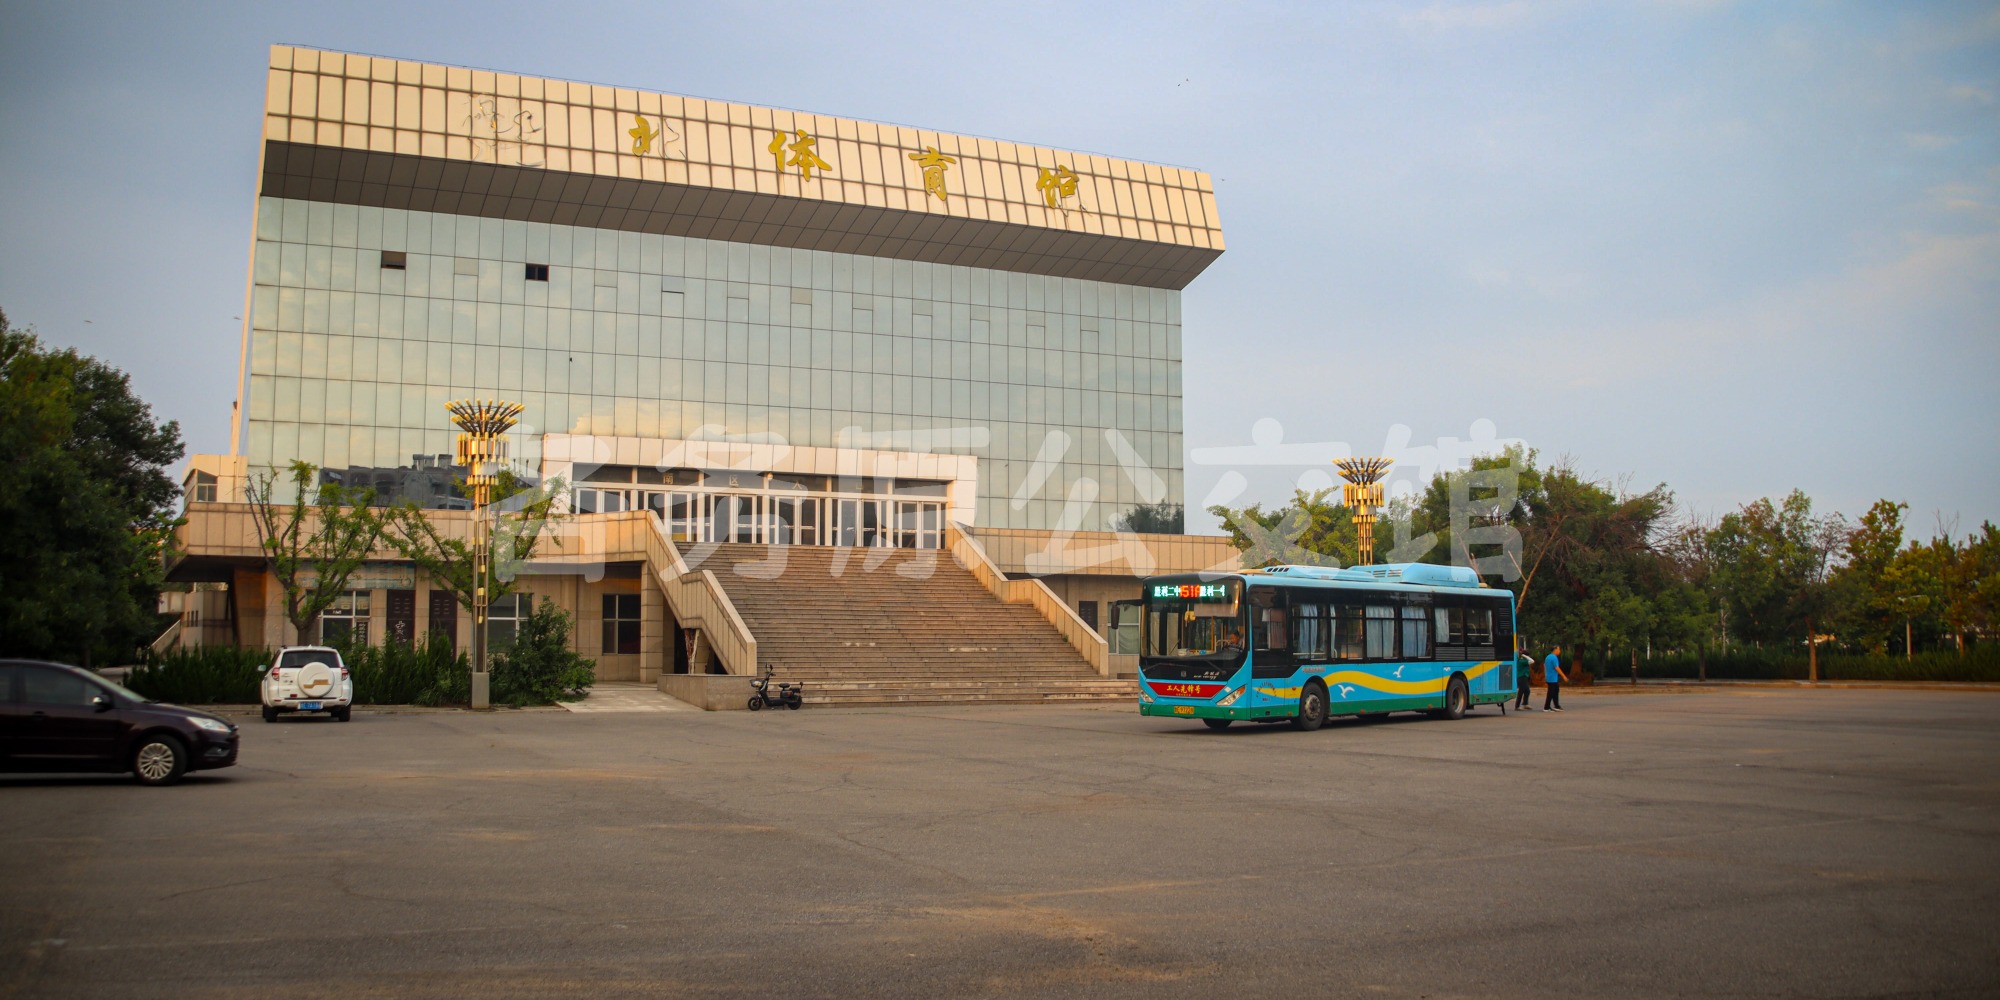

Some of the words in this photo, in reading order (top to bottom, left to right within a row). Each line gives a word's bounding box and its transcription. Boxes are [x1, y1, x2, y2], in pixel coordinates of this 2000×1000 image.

[1166, 684, 1201, 694] 工人先锋号
